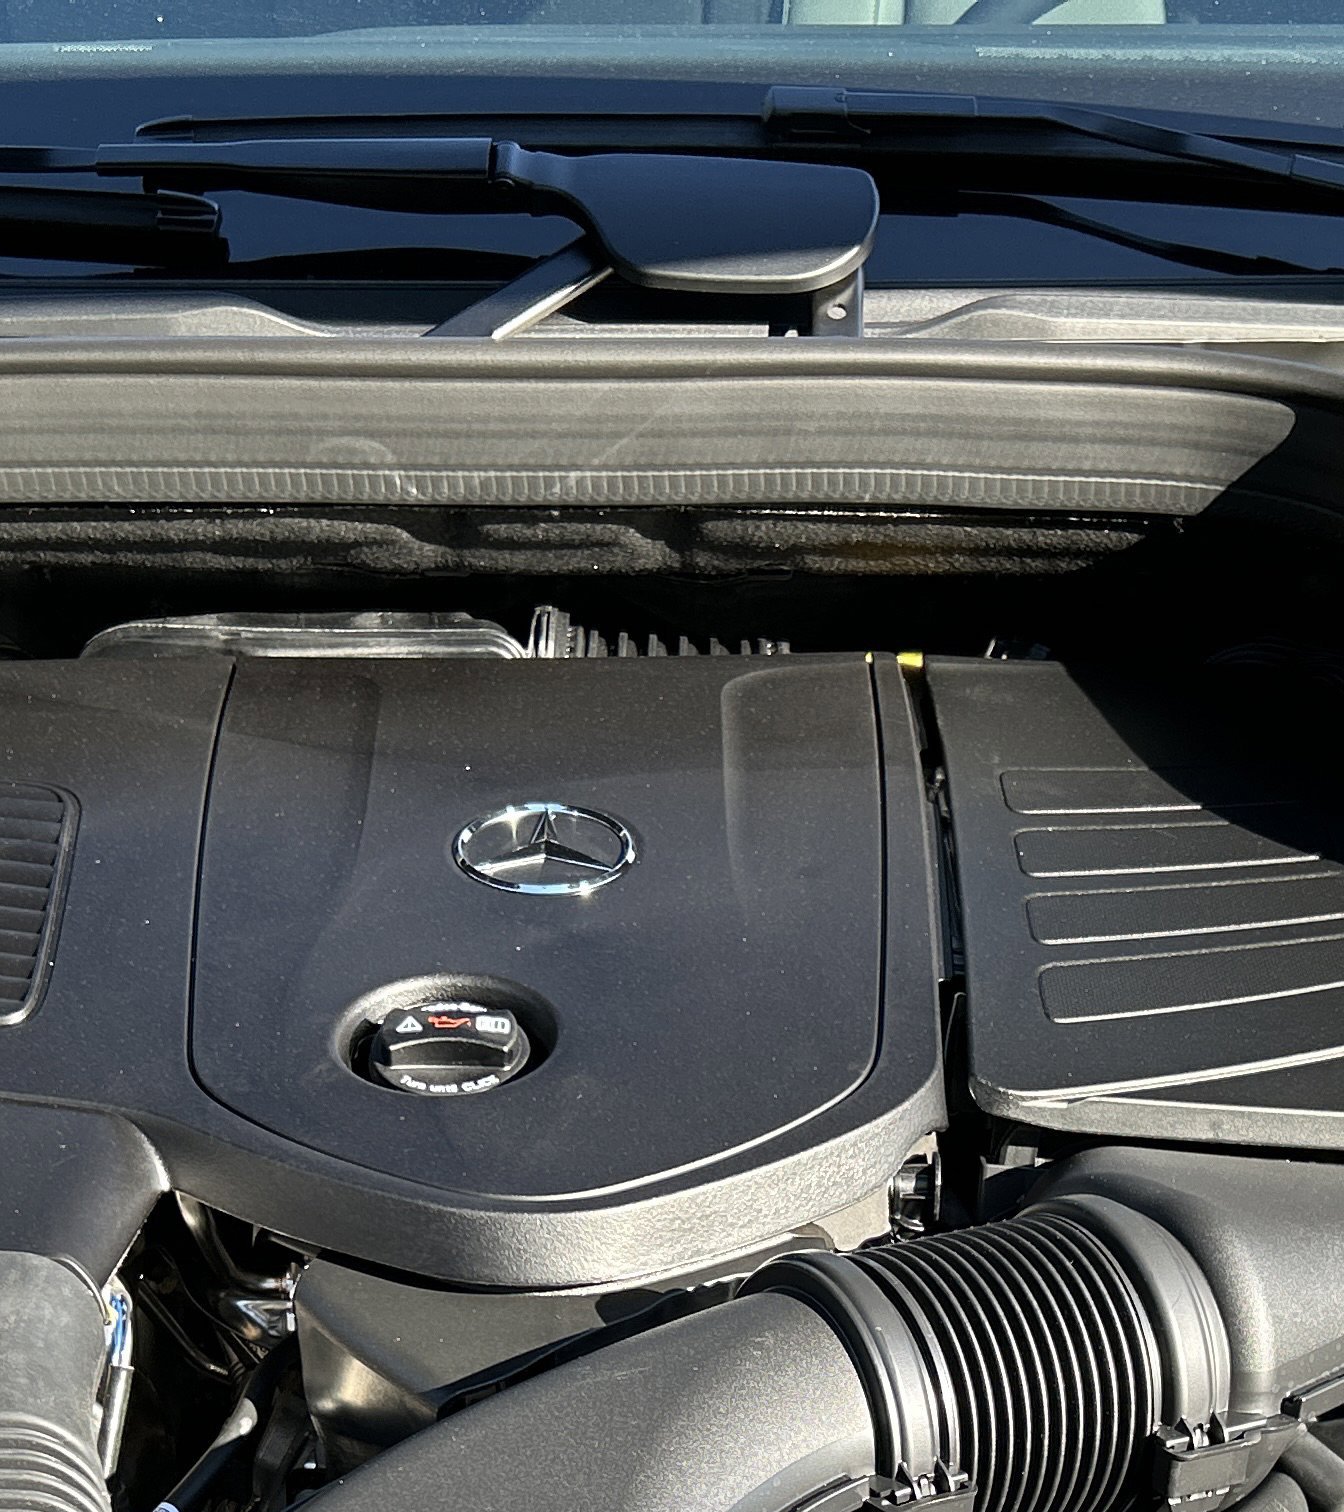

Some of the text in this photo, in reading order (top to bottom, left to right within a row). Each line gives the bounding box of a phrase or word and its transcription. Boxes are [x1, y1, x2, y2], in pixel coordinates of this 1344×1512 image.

[400, 1074, 500, 1093] Turn until CLICK
